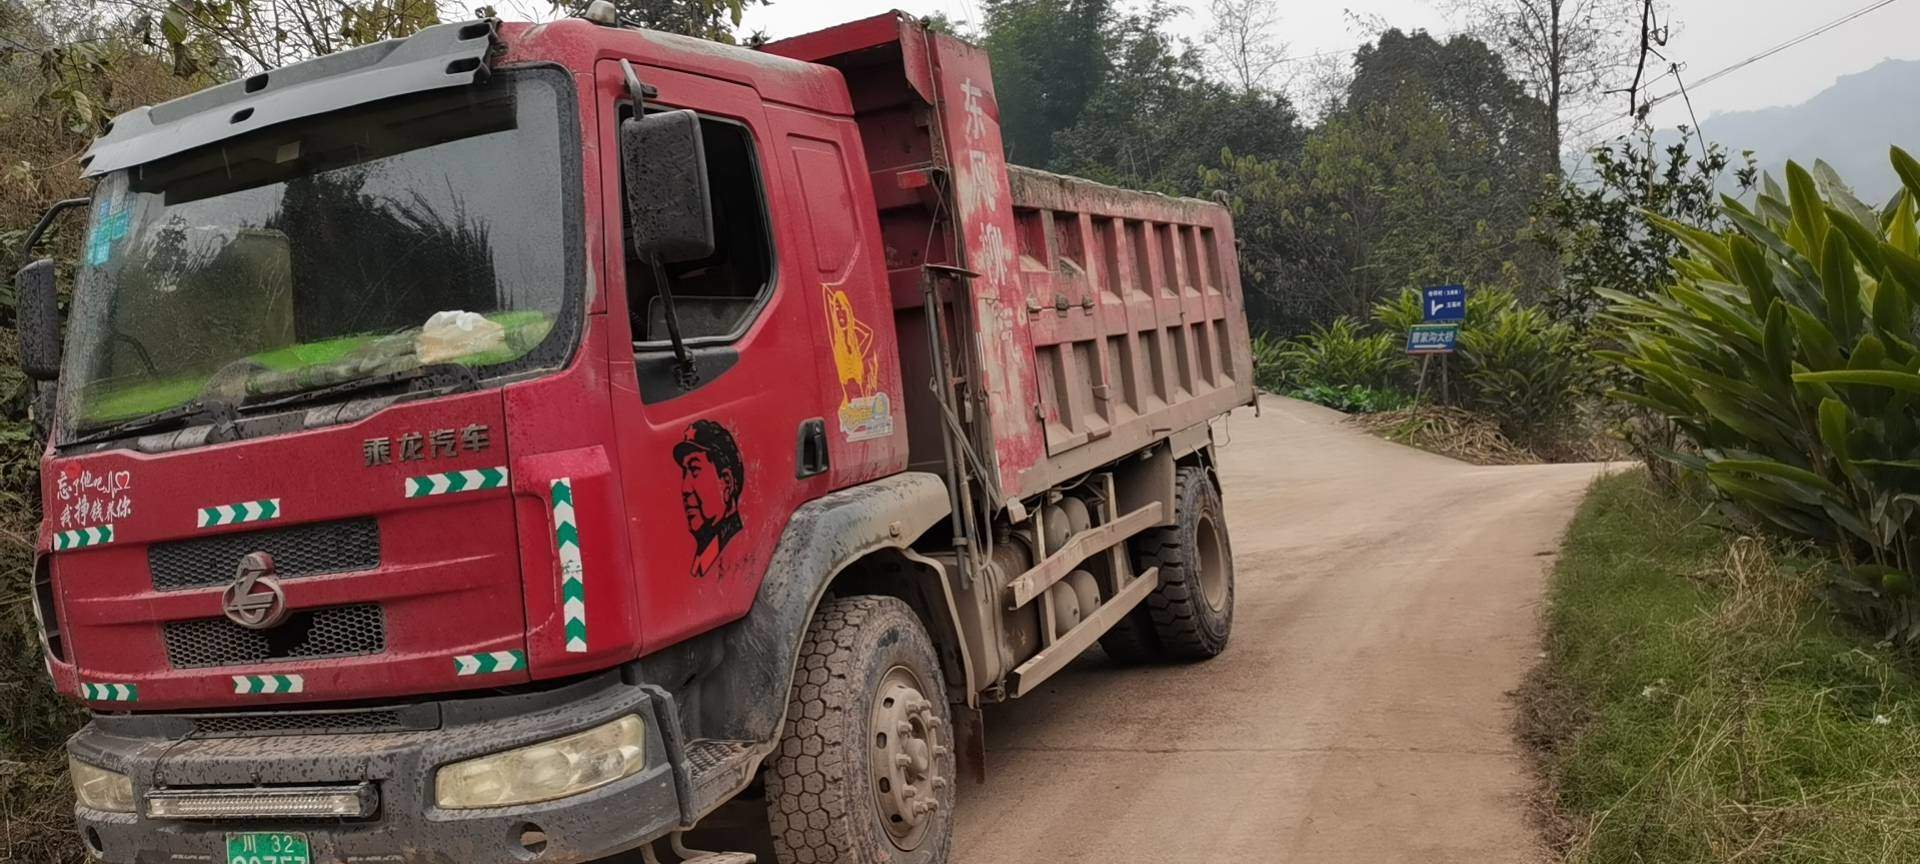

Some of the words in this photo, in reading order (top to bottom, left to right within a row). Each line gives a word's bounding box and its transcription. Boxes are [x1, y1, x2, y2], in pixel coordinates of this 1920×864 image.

[363, 423, 490, 467] 乘龙汽车
[57, 470, 105, 501] 忘了他吧
[60, 494, 132, 528] 我挣钱养你
[243, 834, 257, 853] 川
[271, 835, 294, 853] 32
